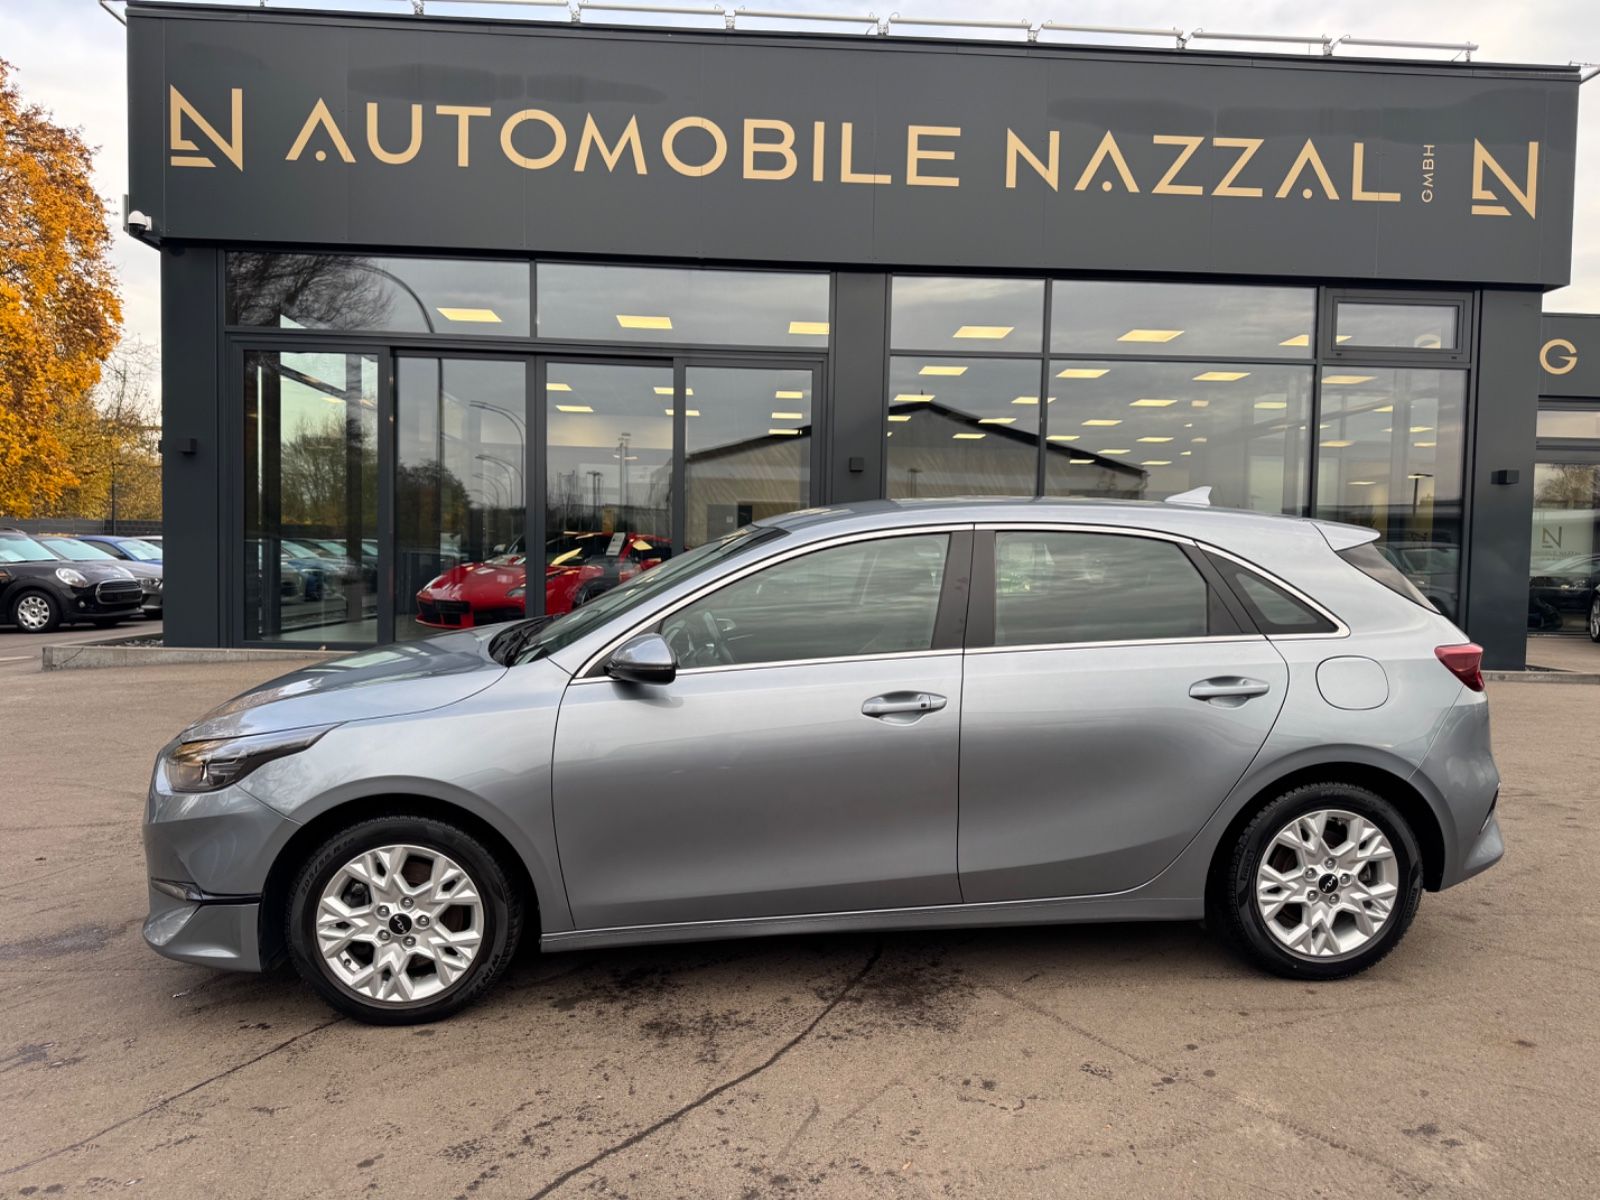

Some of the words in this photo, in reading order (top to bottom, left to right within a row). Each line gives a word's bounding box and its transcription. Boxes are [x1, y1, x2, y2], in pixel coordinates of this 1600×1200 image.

[286, 98, 962, 188] AUTOMOBILE
[1005, 130, 1402, 203] NAZZAL
[1421, 144, 1435, 203] GMBH
